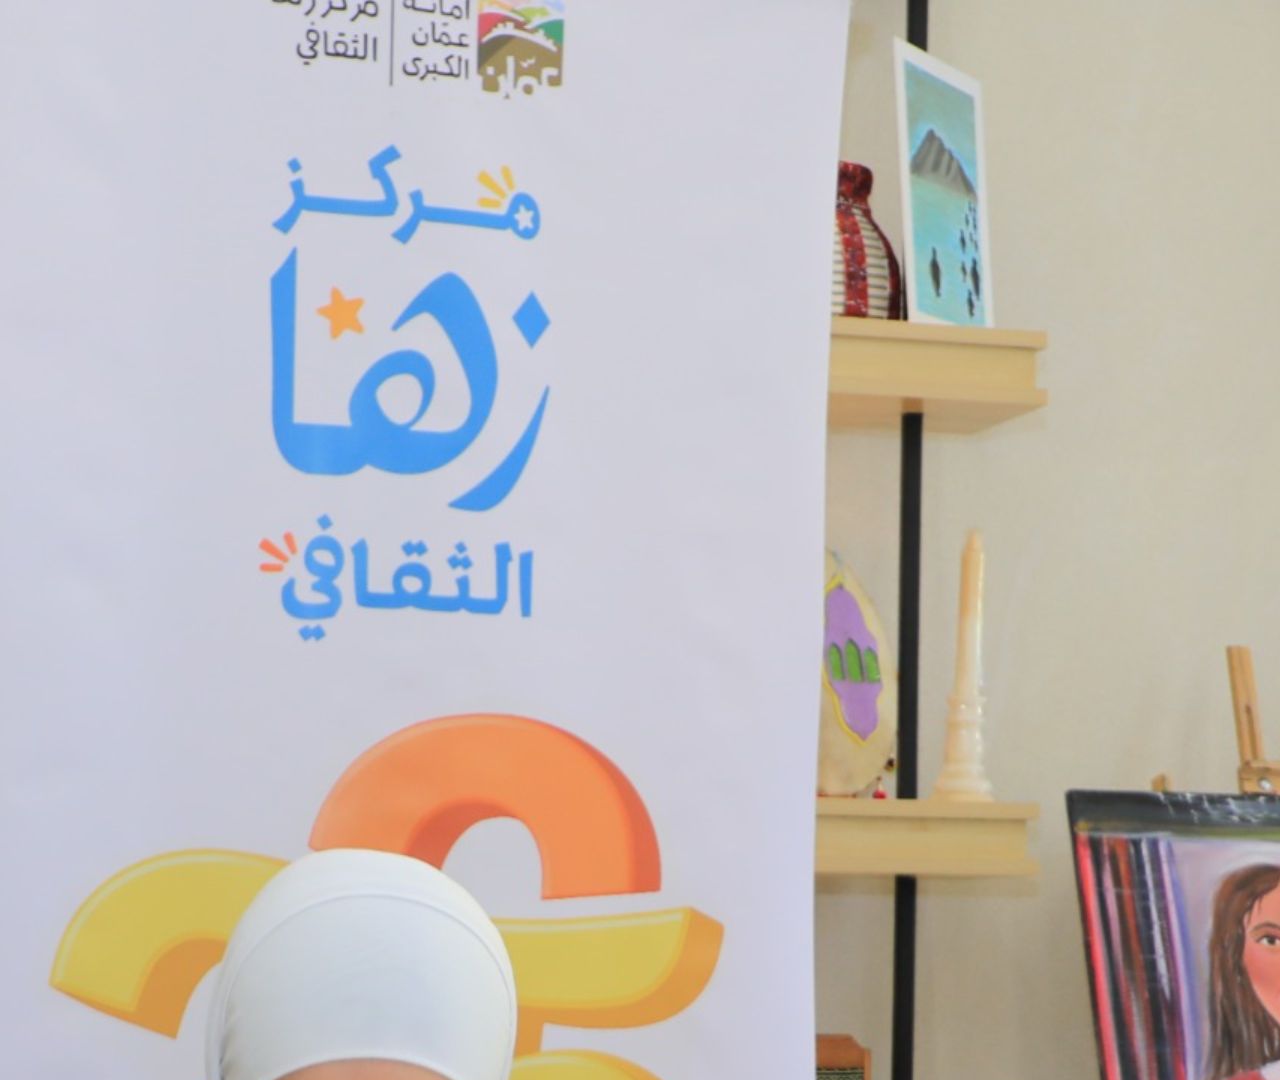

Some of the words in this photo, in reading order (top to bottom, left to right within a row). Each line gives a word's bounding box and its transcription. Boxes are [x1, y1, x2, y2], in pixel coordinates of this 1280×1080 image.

[296, 21, 377, 66] الثقافي
[402, 54, 470, 81] الكبرى
[272, 144, 541, 245] مركز
[270, 247, 550, 513] زها
[281, 514, 535, 642] الثقافي
